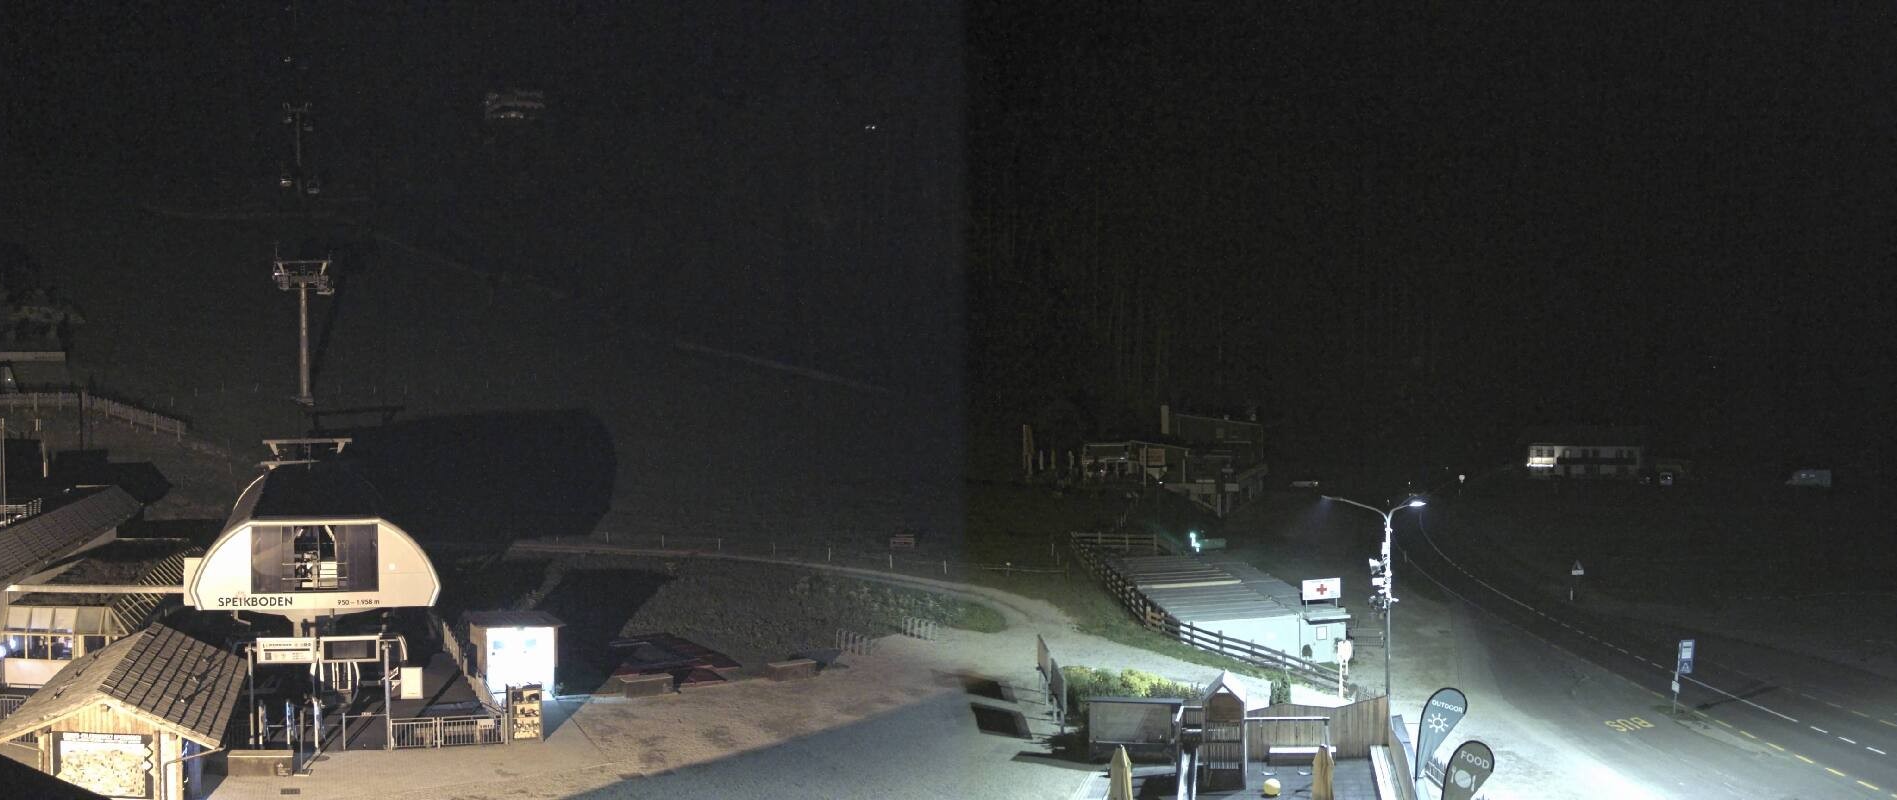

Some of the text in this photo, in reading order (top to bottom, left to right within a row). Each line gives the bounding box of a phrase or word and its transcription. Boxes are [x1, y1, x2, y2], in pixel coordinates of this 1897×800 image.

[218, 596, 293, 607] SPEIKBODEN
[1432, 700, 1463, 714] OUTDOOR
[1605, 717, 1655, 731] BUS
[1460, 751, 1490, 769] FOOD
